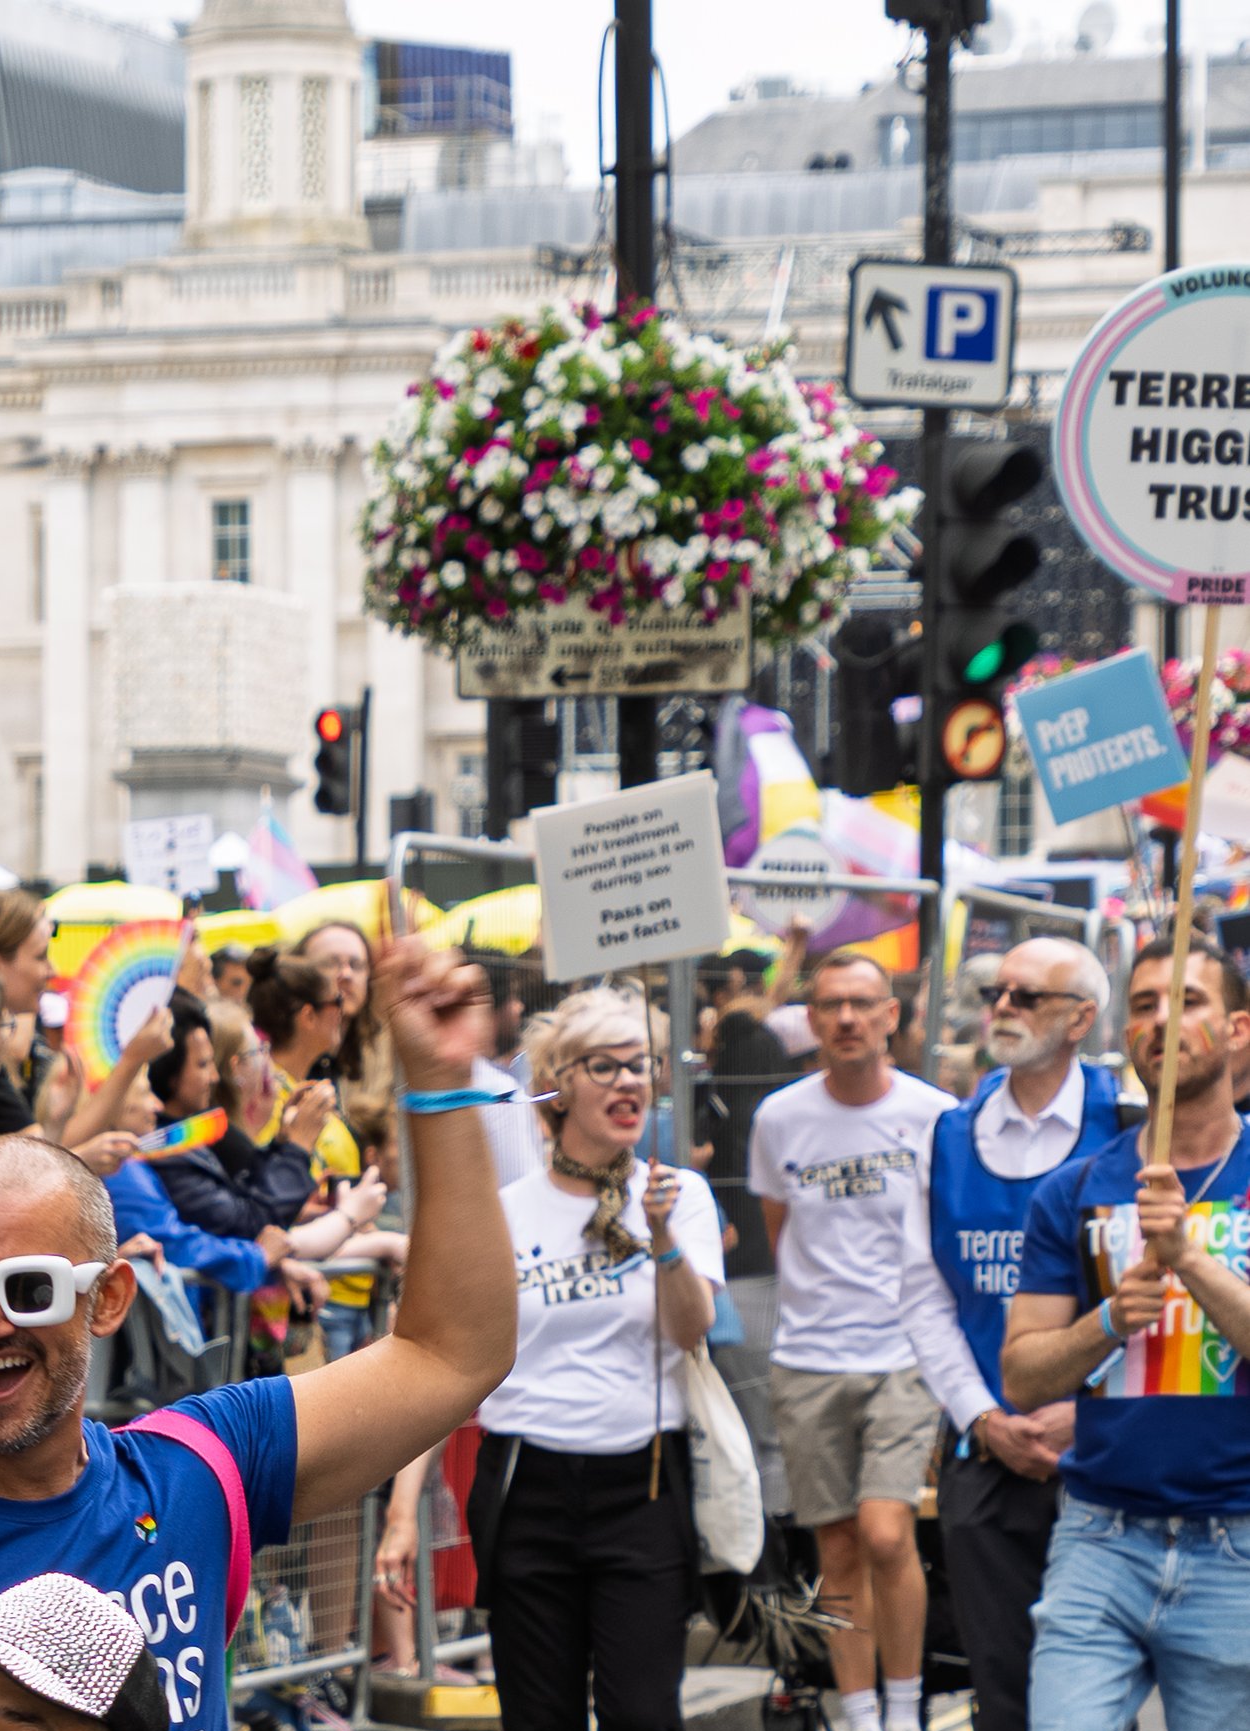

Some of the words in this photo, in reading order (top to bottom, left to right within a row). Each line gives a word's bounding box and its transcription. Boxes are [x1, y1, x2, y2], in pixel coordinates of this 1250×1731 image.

[937, 291, 987, 357] P
[886, 367, 976, 394] Trafalgar
[1130, 426, 1250, 466] HIGG
[1187, 577, 1247, 594] PRIDE
[1201, 595, 1247, 605] LONDON
[1036, 707, 1090, 753] PrEP
[1047, 724, 1168, 790] PROTECTS.
[584, 813, 639, 836] People
[642, 808, 664, 824] on
[571, 842, 599, 859] HIV
[602, 822, 680, 850] treatment
[563, 857, 617, 880] cannot
[621, 848, 656, 868] pass
[673, 838, 695, 852] on
[591, 871, 643, 893] during
[646, 864, 672, 879] sex
[600, 904, 644, 924] Pass
[647, 897, 672, 913] on
[596, 929, 630, 948] the
[633, 917, 681, 940] facts
[546, 1281, 574, 1303] IT
[575, 1276, 621, 1299] ON
